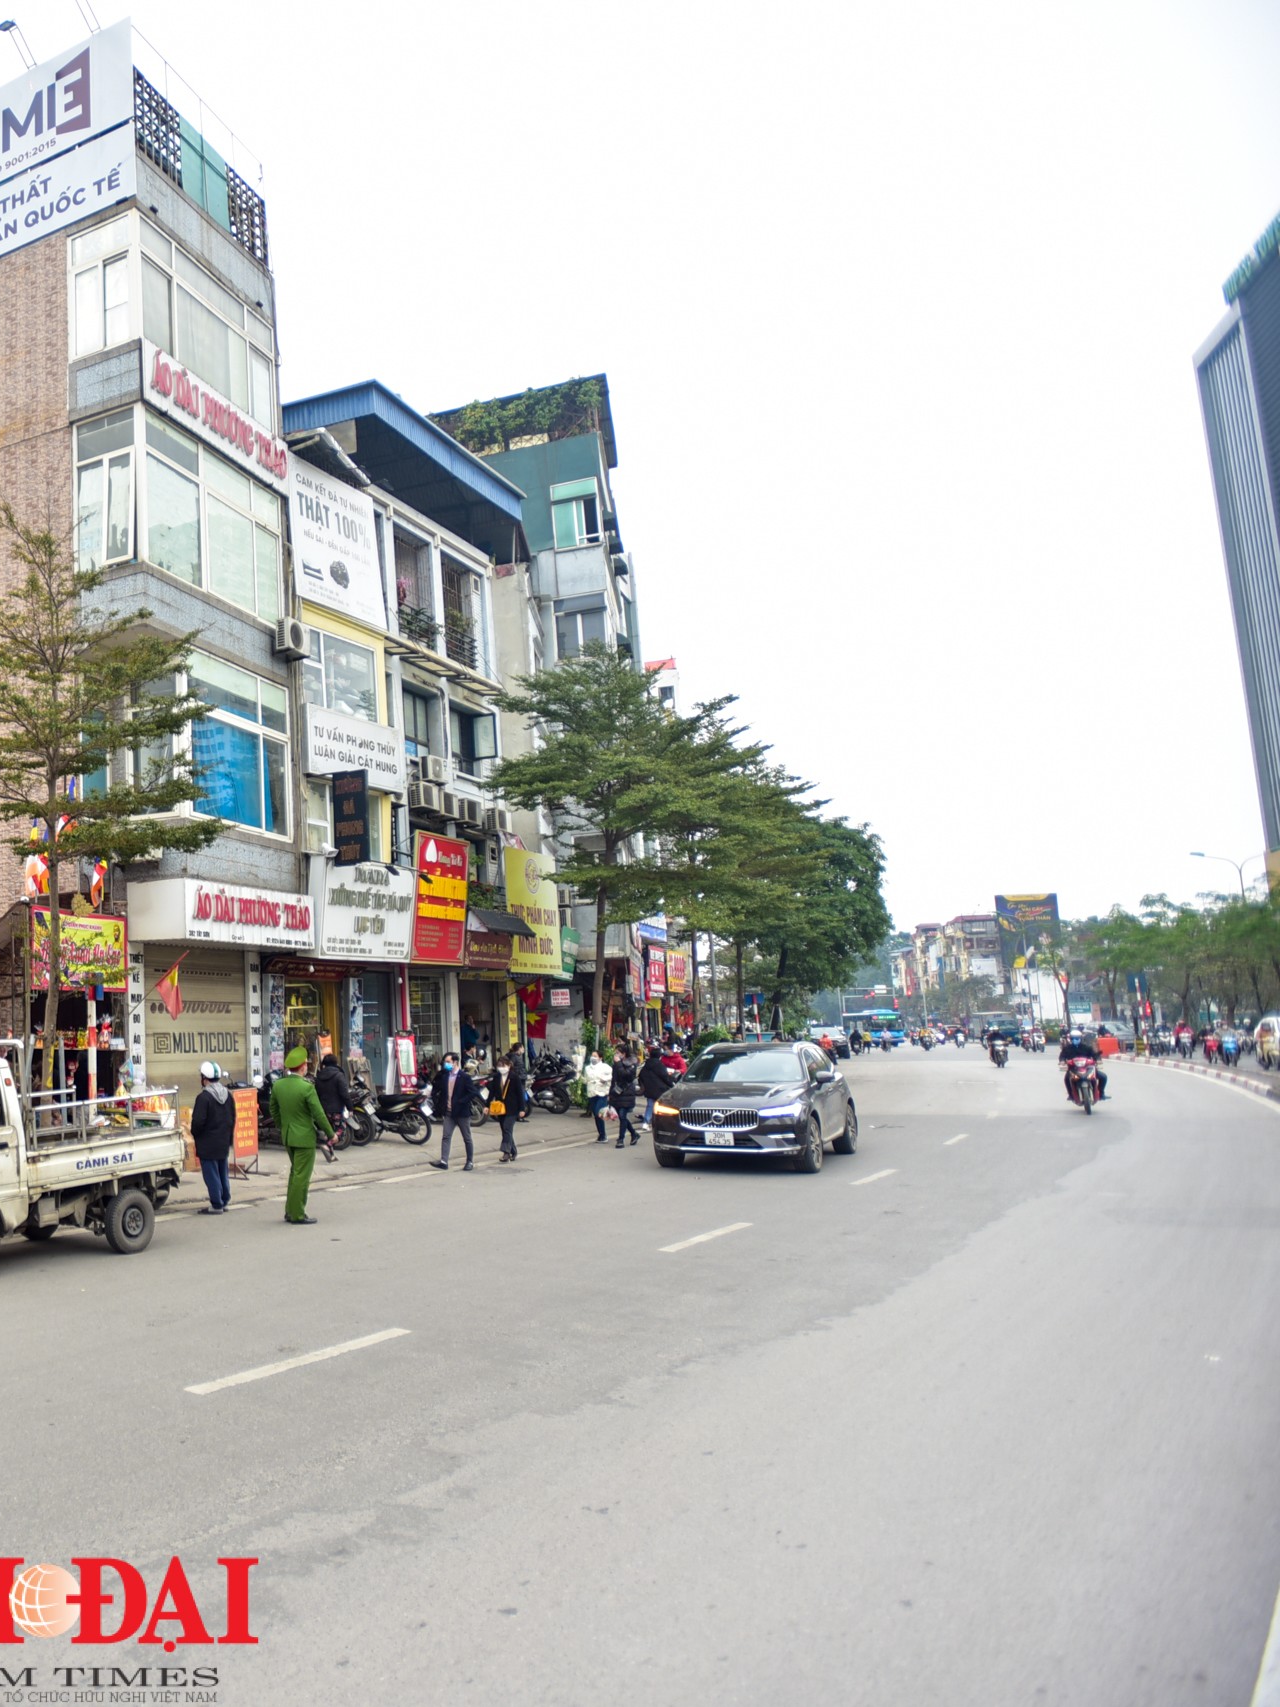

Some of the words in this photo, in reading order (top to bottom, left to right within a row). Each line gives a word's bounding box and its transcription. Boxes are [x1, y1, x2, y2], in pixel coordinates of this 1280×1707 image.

[5, 138, 57, 170] 9001:2015
[24, 185, 86, 229] QUỐC
[93, 161, 123, 197] TẾ
[150, 349, 173, 398] ÁO
[173, 367, 200, 420] DÀI
[296, 473, 313, 490] CAM
[314, 482, 326, 497] KẾT
[297, 490, 330, 531] THẬT
[335, 511, 371, 550] 100%
[314, 725, 324, 738] TƯ
[326, 727, 344, 744] VẤN
[314, 744, 336, 762] LUẬN
[357, 754, 374, 769] CÁT
[193, 885, 212, 920] ÁO
[212, 888, 235, 923] DÀI
[236, 895, 281, 928] PHƯƠNG
[131, 993, 142, 1004] MAY
[173, 1032, 239, 1054] MULTICODE
[113, 1153, 134, 1165] SÁT
